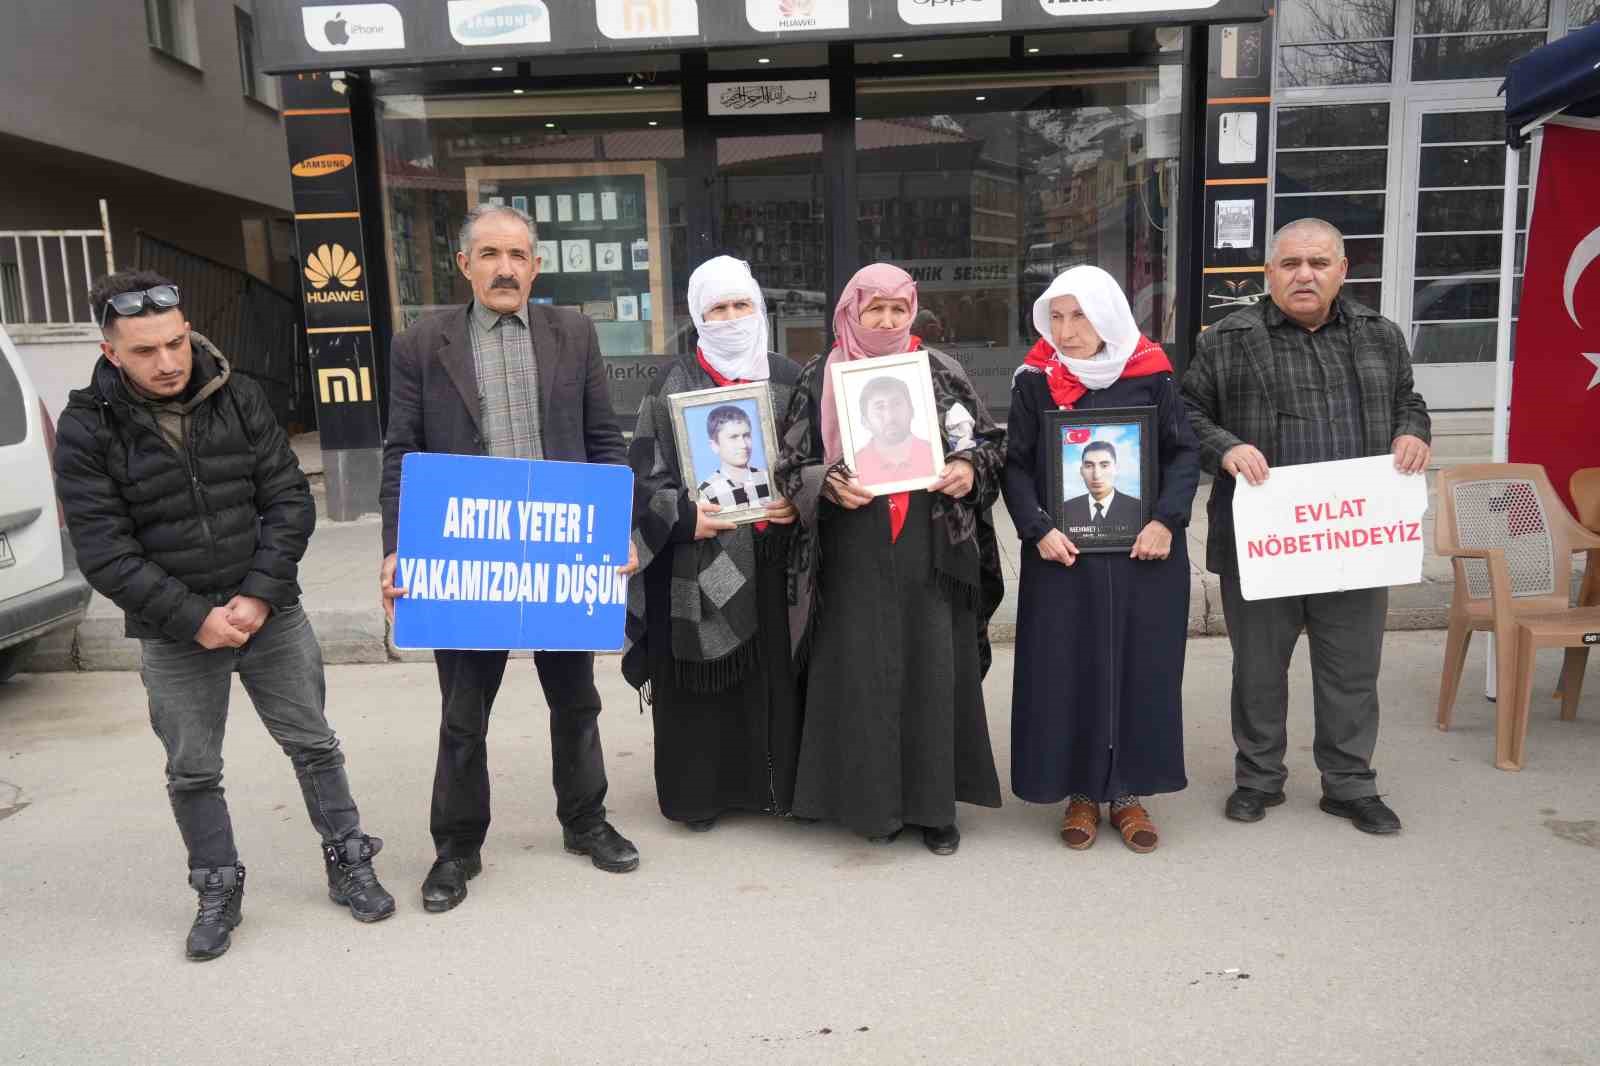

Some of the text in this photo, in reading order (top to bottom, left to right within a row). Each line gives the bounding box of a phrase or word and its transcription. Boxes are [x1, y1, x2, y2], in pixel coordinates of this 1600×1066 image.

[300, 158, 346, 170] SAMSUNG
[306, 289, 364, 303] HUAWEI
[443, 497, 512, 541] ARTIK
[517, 500, 582, 544] YETER
[1294, 498, 1367, 524] EVLAT
[1247, 520, 1422, 559] NÖBETİNDEYİZ
[400, 553, 628, 617] YAKAMIZDAN DÜŞÜN
